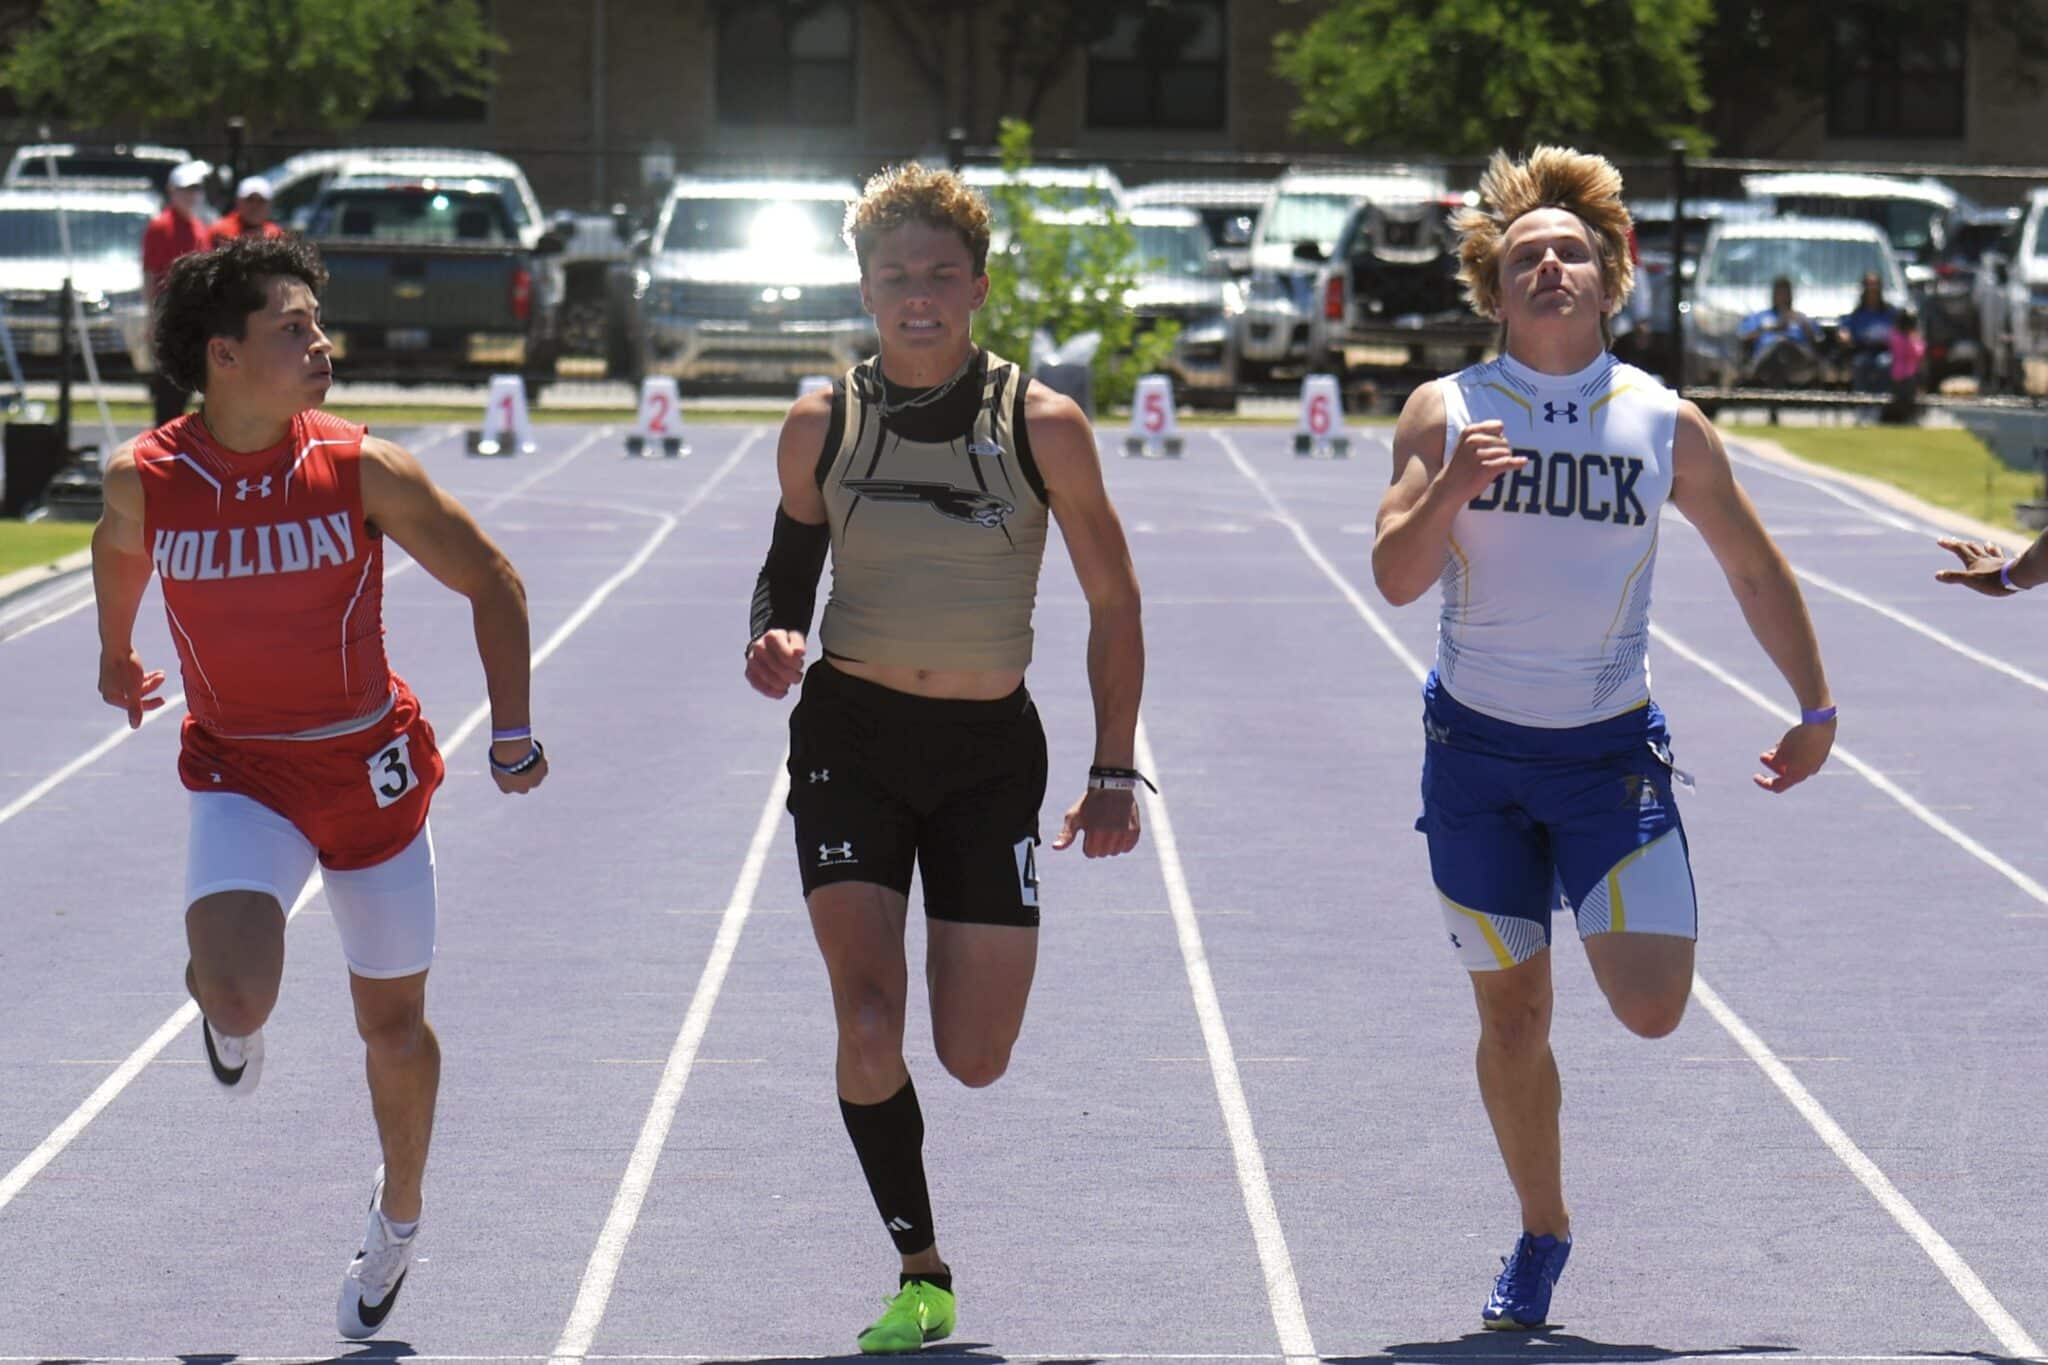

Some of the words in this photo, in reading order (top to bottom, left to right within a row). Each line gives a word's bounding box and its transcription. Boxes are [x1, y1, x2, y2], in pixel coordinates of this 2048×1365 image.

[501, 396, 514, 432] 1
[648, 394, 668, 433] 2
[1143, 394, 1165, 433] 5
[1308, 395, 1329, 434] 6
[152, 510, 355, 581] HOLLIDAY
[379, 747, 408, 798] 3
[1023, 841, 1039, 901] 4
